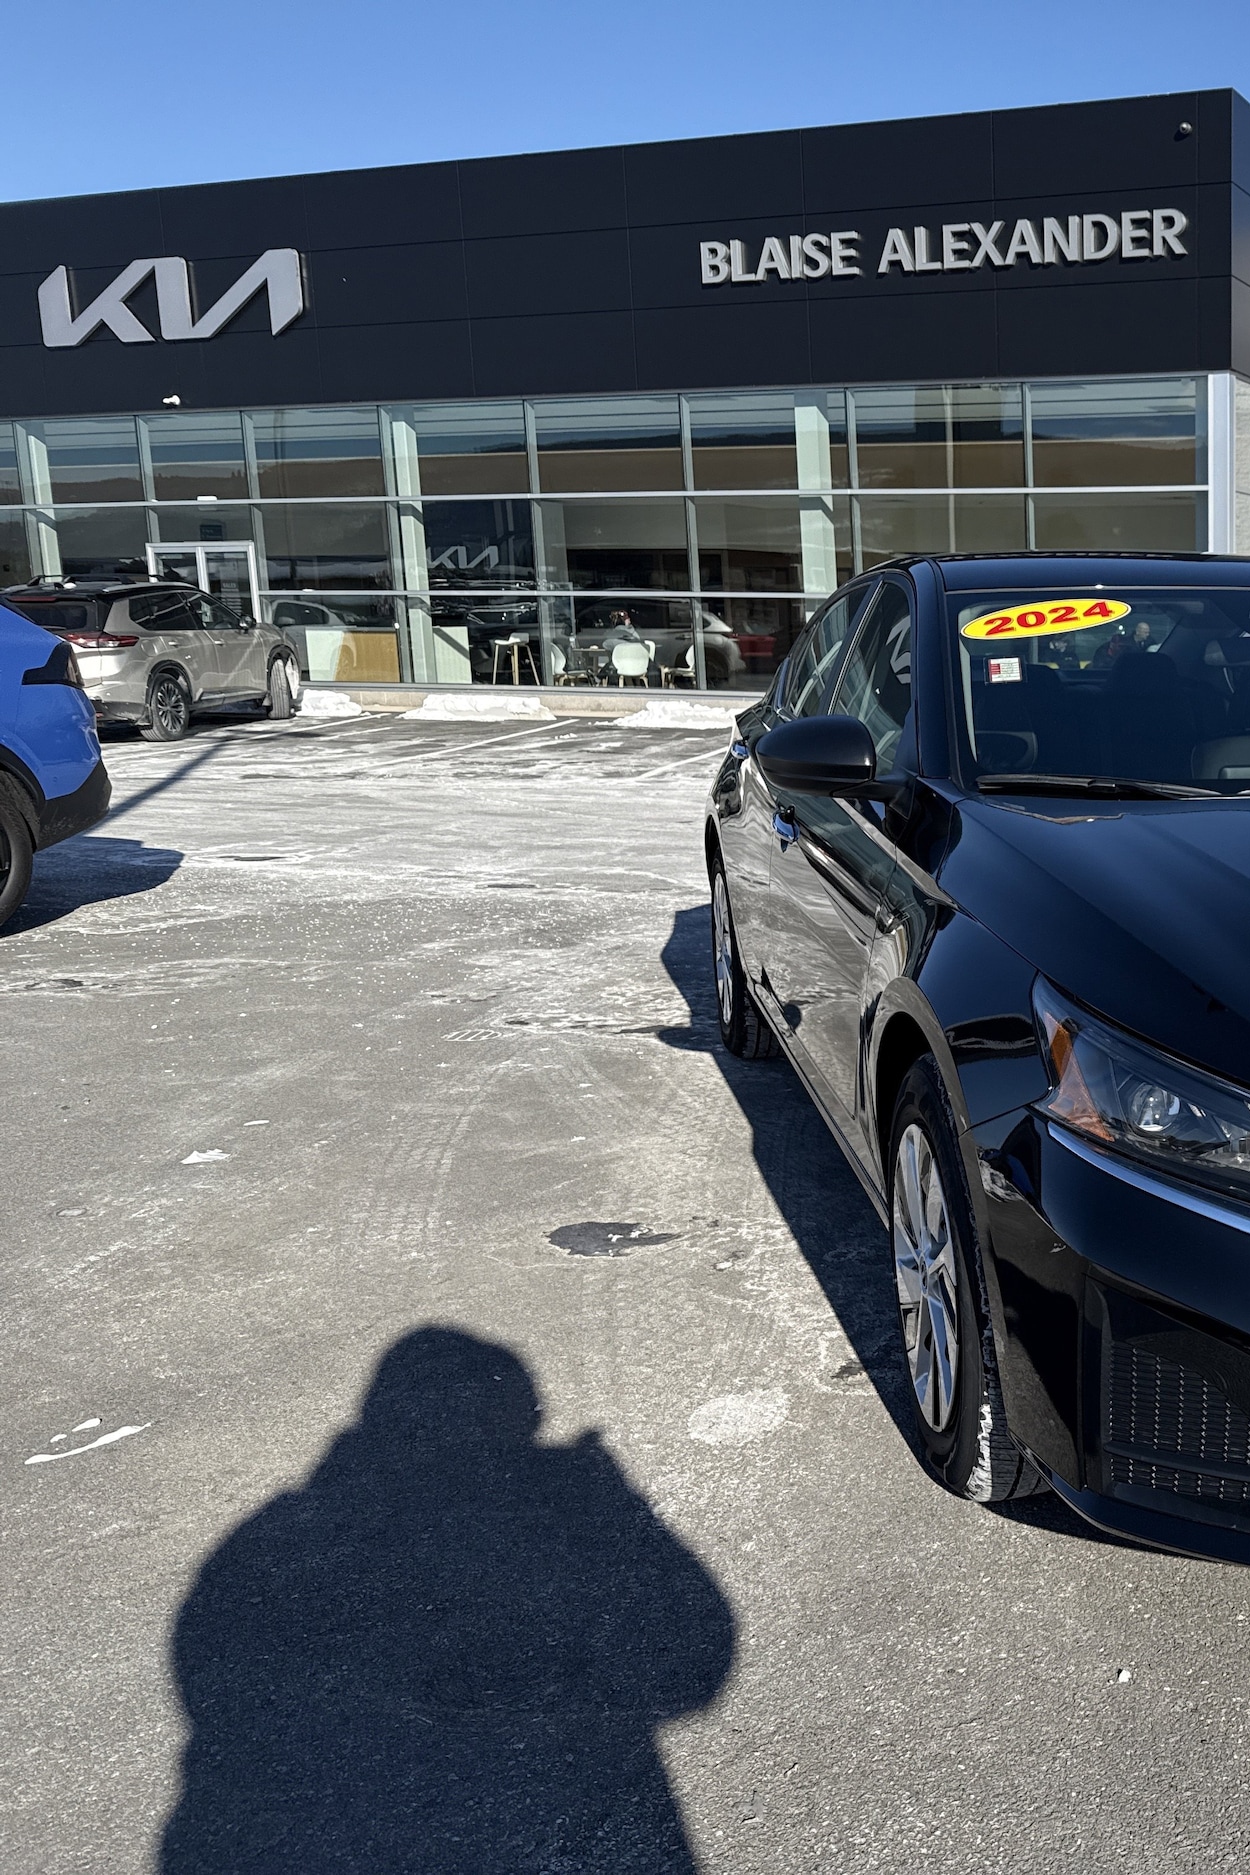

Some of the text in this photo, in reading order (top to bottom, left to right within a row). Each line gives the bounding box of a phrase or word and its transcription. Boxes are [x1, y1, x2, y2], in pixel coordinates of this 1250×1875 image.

[699, 207, 1189, 285] BLAISE ALEXANDER
[37, 247, 304, 348] KIA
[983, 600, 1114, 636] 2024
